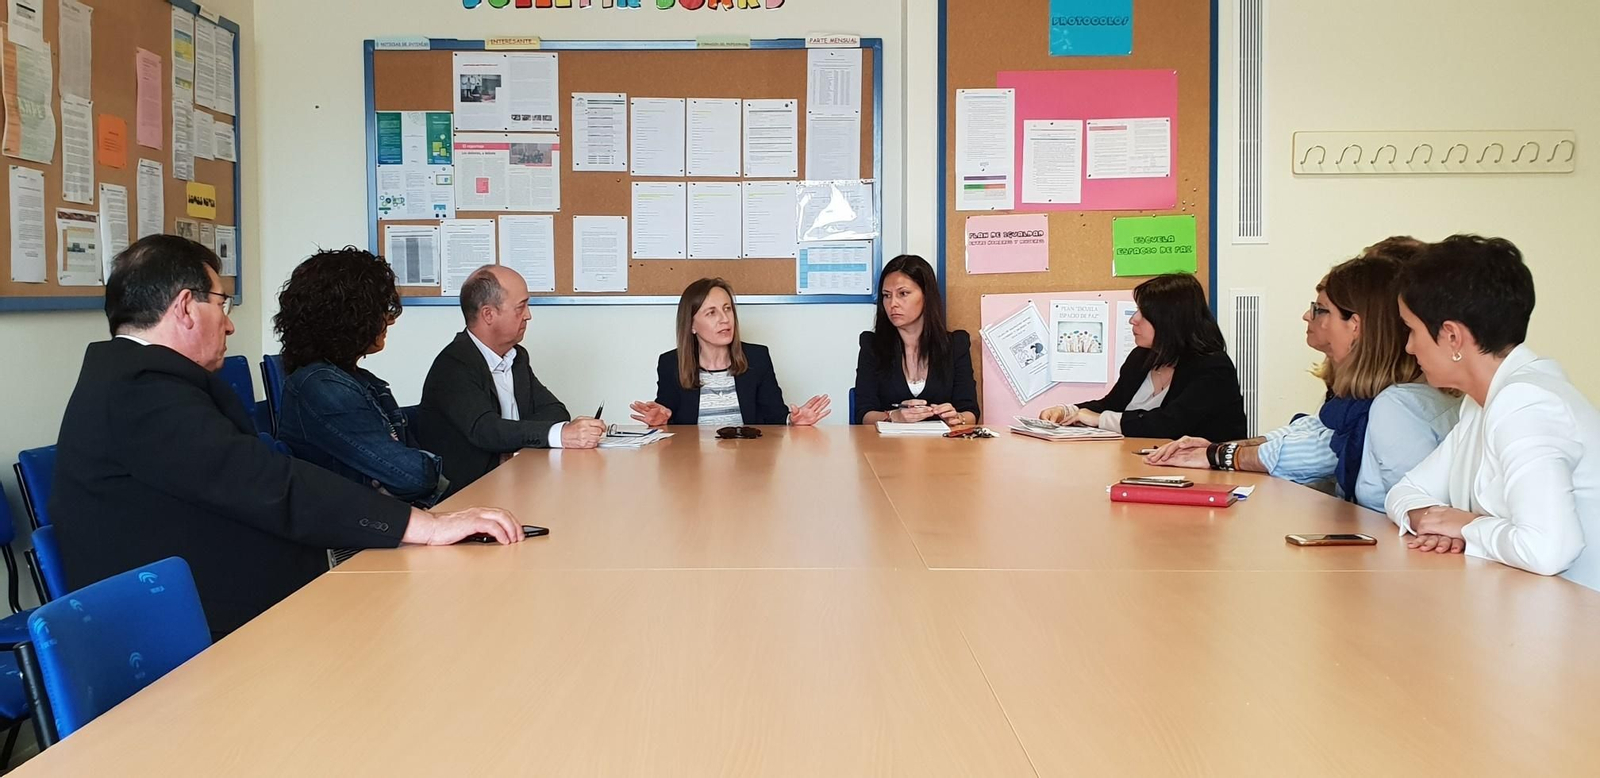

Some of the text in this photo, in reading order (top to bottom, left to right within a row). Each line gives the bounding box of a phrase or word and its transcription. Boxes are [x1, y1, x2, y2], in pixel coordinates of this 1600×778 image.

[1051, 16, 1129, 26] PROTOCOLOS
[1003, 230, 1045, 239] IGUALDAD
[1133, 235, 1175, 244] ESCUELA
[1116, 245, 1193, 256] ESPACIO DE PAZ
